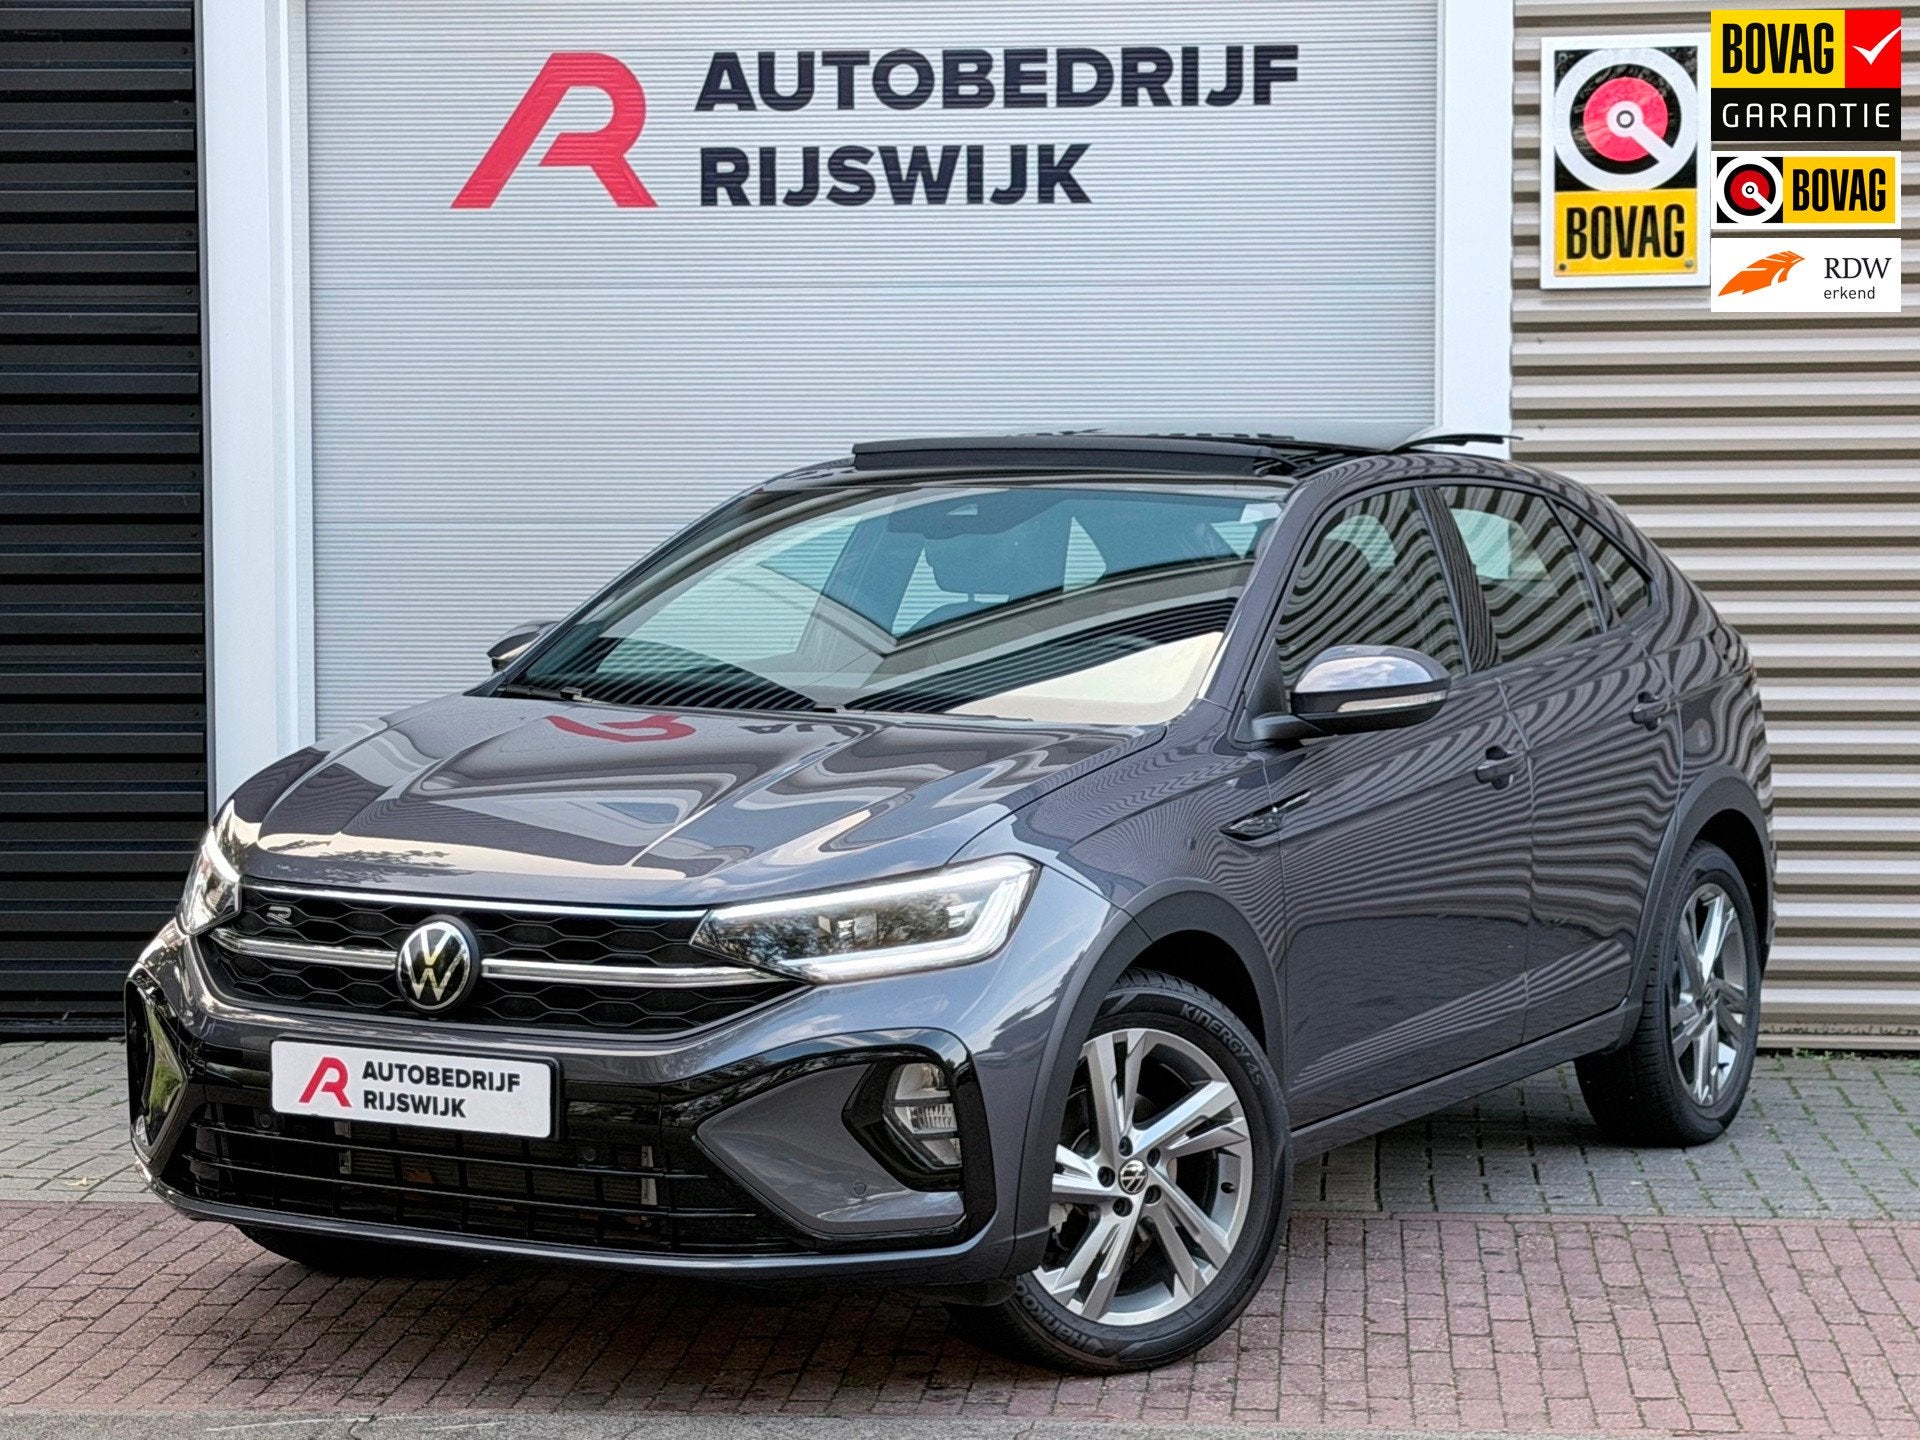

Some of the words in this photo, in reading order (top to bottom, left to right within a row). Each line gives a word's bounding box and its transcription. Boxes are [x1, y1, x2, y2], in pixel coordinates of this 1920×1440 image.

[694, 44, 1299, 113] AUTOBEDRIJF
[699, 143, 1093, 208] RIJSWIJK
[1565, 203, 1686, 260] BOVAG
[362, 1061, 520, 1092] AUTOBEDRIJF
[363, 1090, 466, 1118] RIJSWIJK
